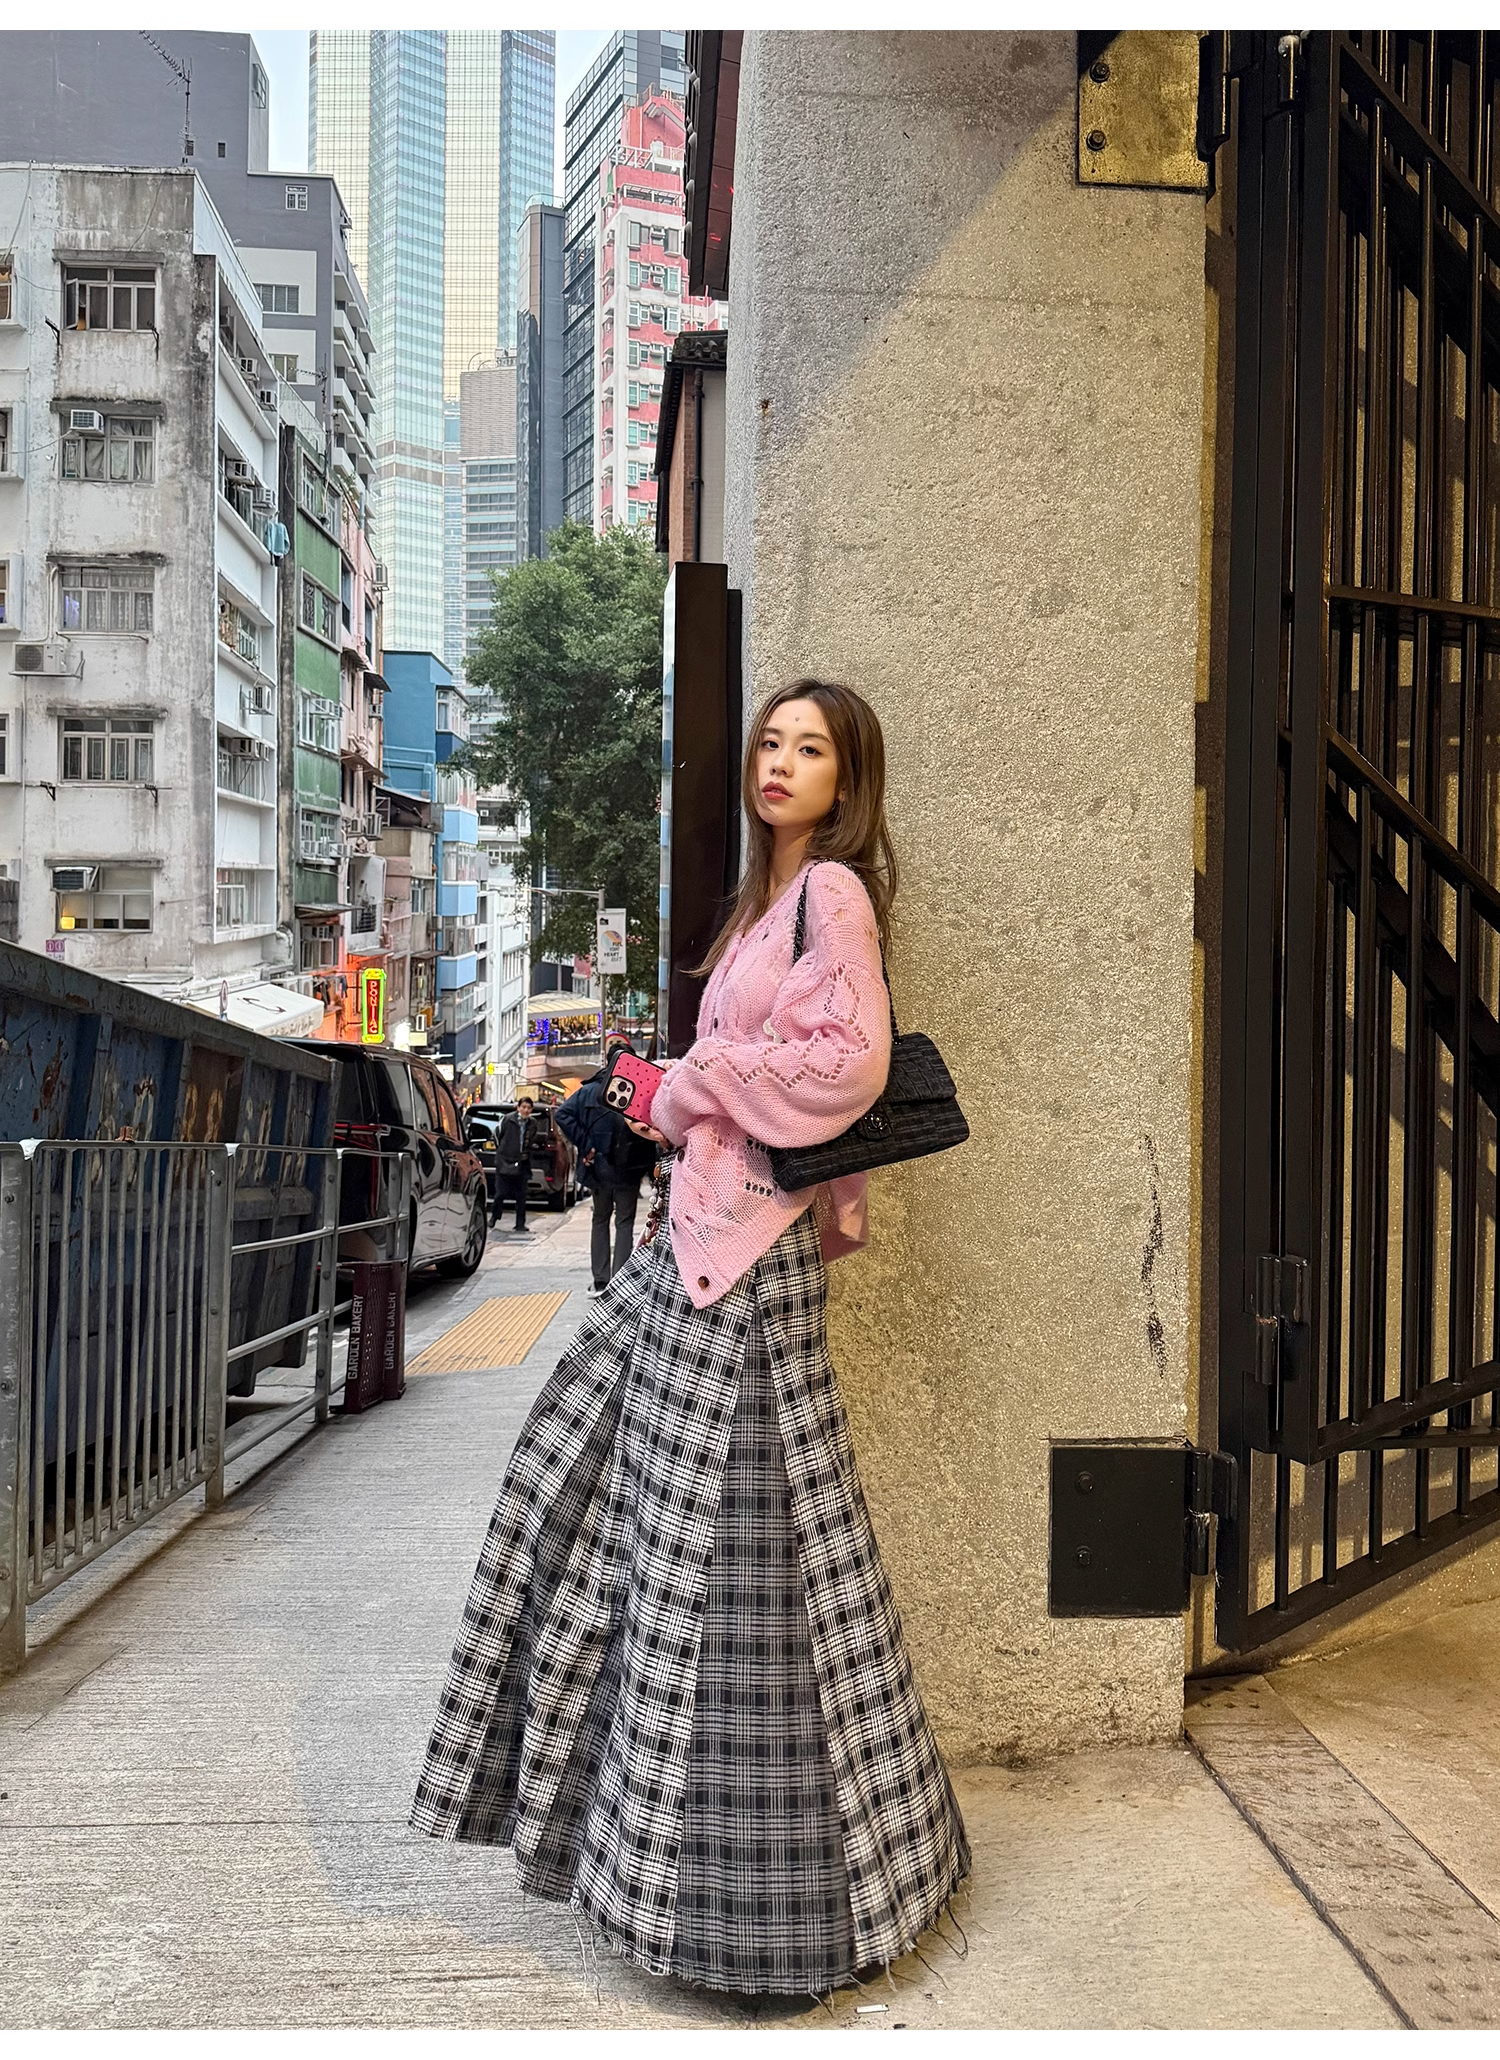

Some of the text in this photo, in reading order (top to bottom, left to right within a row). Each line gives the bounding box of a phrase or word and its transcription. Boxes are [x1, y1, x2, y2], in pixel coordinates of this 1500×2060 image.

[369, 981, 378, 1033] PONTIAC
[347, 1294, 364, 1380] GARDEN BAKERY
[384, 1330, 395, 1370] GARDEN
